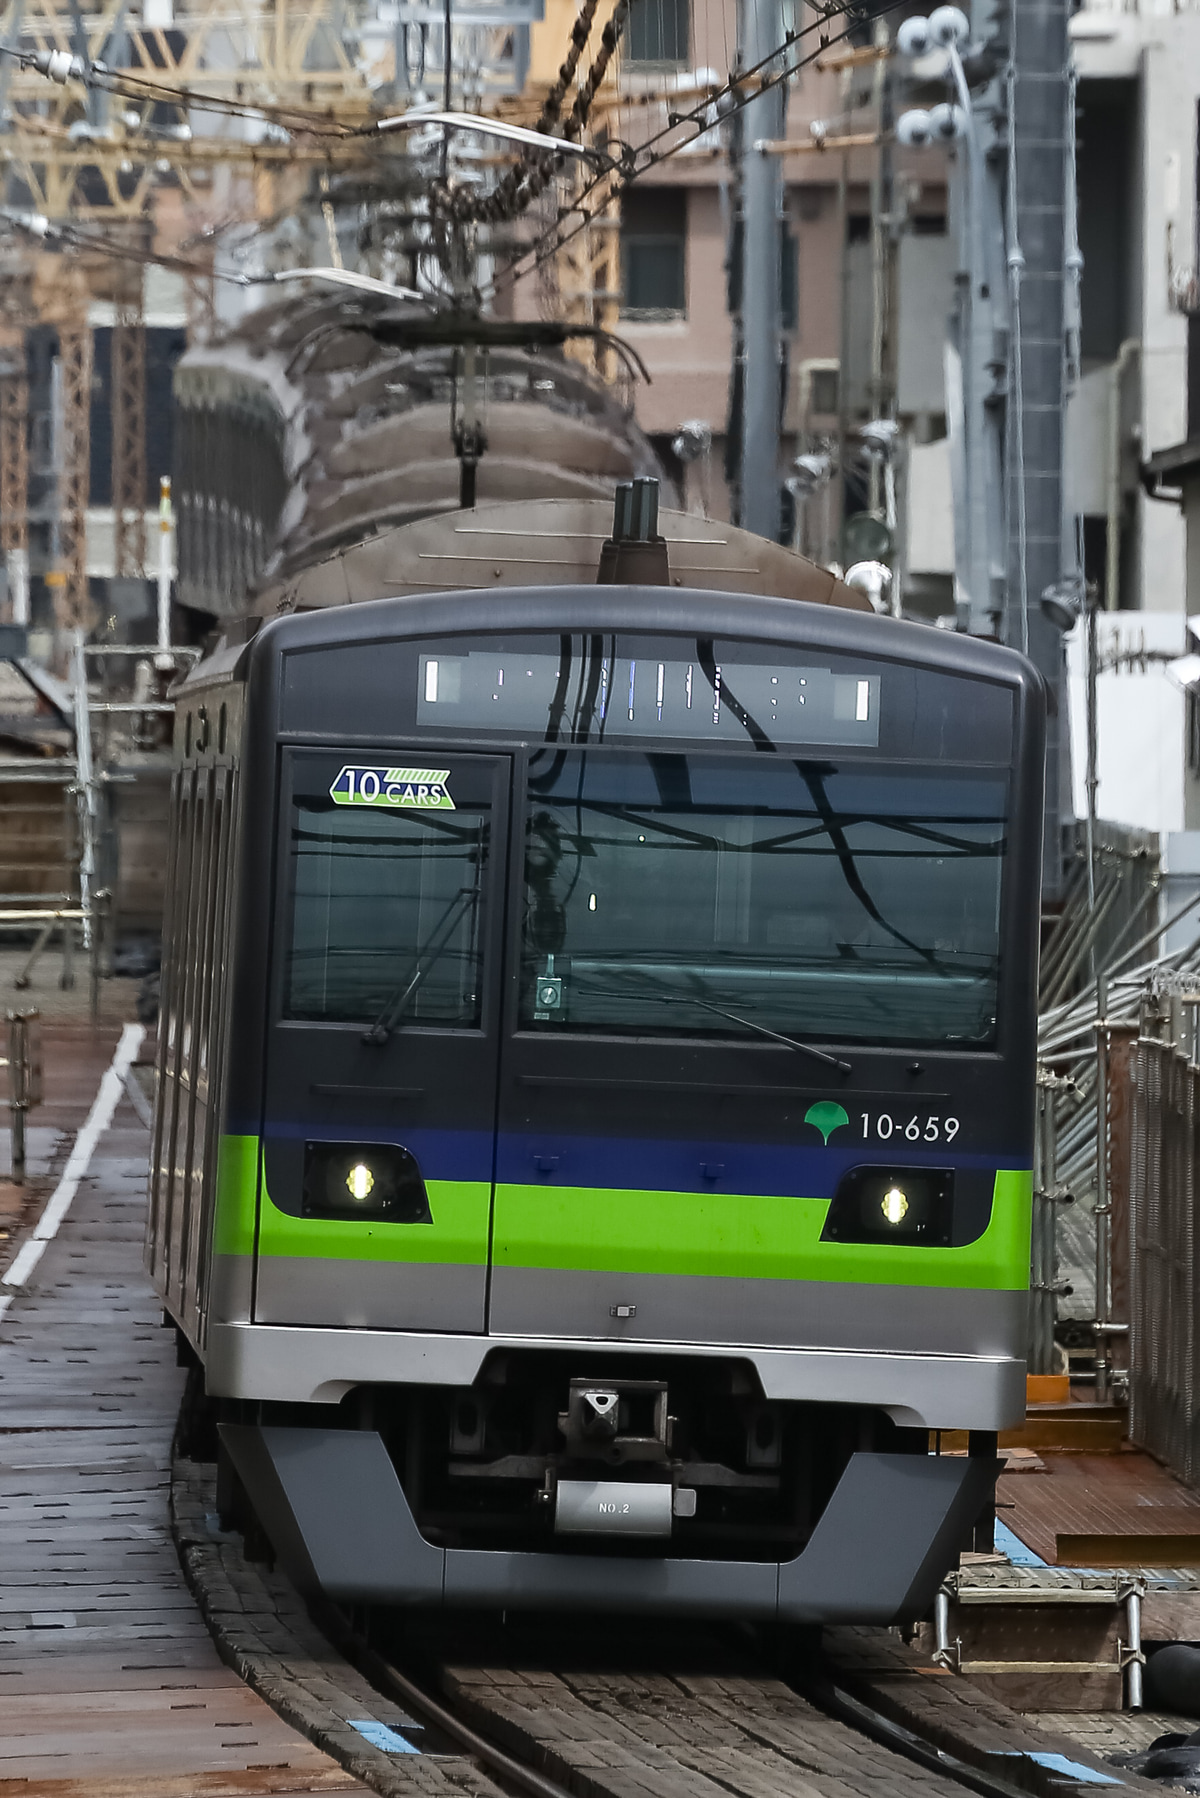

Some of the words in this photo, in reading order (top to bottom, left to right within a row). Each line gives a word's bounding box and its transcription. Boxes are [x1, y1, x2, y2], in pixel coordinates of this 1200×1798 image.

[345, 770, 380, 802] 10
[386, 783, 442, 805] CARS
[860, 1113, 960, 1143] 10-659
[599, 1503, 630, 1514] NO.2
